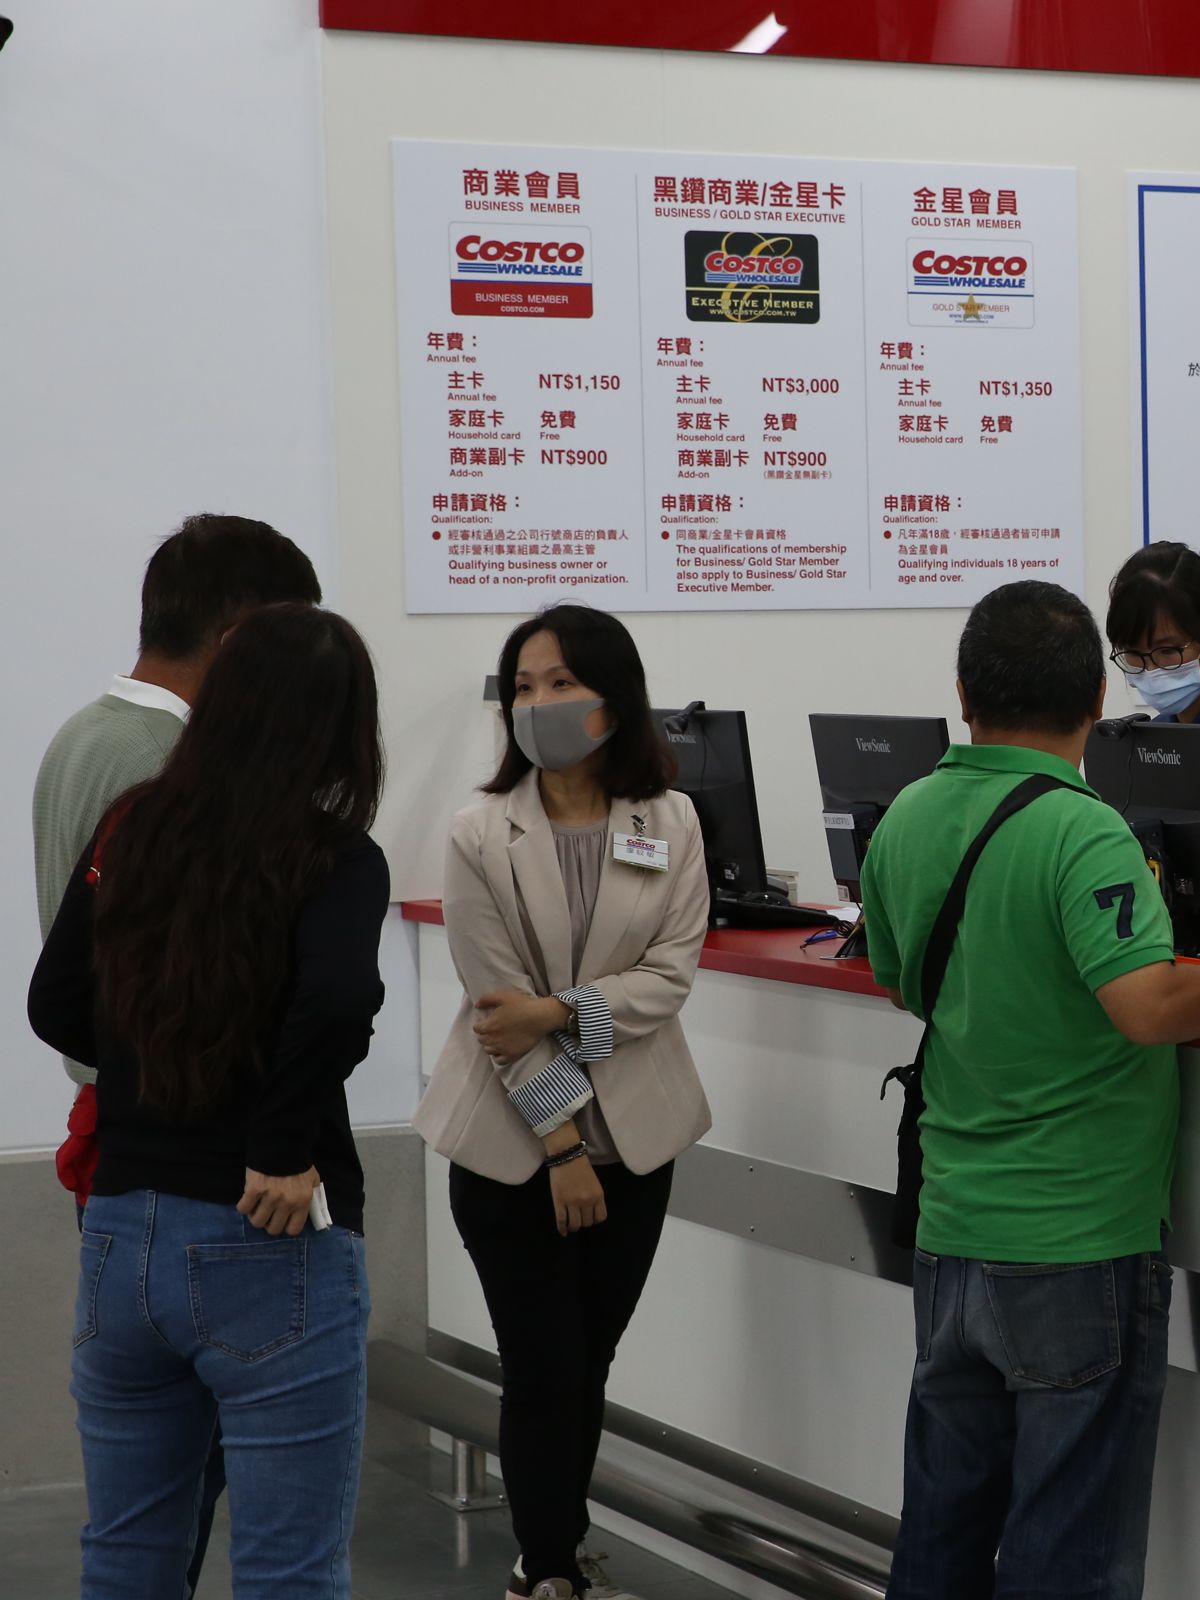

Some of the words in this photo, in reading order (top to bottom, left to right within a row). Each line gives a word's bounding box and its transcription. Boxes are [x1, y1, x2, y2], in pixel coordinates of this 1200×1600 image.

[462, 168, 581, 200] 商業會員
[653, 176, 846, 209] 黑鑽商業/金星卡
[465, 200, 524, 212] BUSINESS
[530, 202, 580, 214] MEMBER
[912, 186, 1018, 216] 金星會員
[655, 207, 711, 219] BUSINESS
[713, 209, 718, 219] /
[720, 209, 751, 220] GOLD
[754, 211, 782, 221] STAR
[911, 216, 941, 227] GOLD
[944, 217, 971, 228] STAR
[976, 219, 1021, 230] MEMBER
[455, 235, 585, 263] COSTCO
[704, 251, 803, 275] COSTCO
[912, 250, 1028, 276] COSTCO
[497, 264, 583, 276] WHOLESALE
[736, 274, 800, 284] WHOLESALE
[949, 277, 1026, 289] WHOLESALE
[475, 293, 523, 304] BUSINESS
[527, 294, 569, 304] MEMBER
[763, 297, 814, 309] MEMBER
[427, 354, 460, 363] Annual
[462, 355, 477, 364] fee
[657, 359, 688, 368] Annual
[690, 359, 704, 368] fee
[448, 371, 485, 390] 主卡
[539, 374, 620, 392] NT$1,150
[676, 375, 711, 393] 主卡
[762, 378, 839, 395] NT$3,000
[898, 378, 931, 396] 主卡
[980, 381, 1053, 398] NT$1,350
[447, 392, 480, 402] Annual
[482, 393, 497, 402] fee
[448, 409, 505, 428] 家庭卡
[540, 410, 576, 429] 免費
[677, 412, 730, 431] 家庭卡
[764, 413, 798, 431] 免費
[899, 415, 949, 433] 家庭卡
[981, 415, 1013, 433] 免費
[448, 431, 499, 440] Household
[500, 432, 521, 440] card
[540, 432, 561, 441] Free
[677, 433, 724, 442] Household
[725, 434, 745, 442] card
[763, 433, 783, 443] Free
[449, 447, 526, 466] 商業副卡
[541, 449, 608, 466] NT$900
[678, 449, 750, 468] 商業副卡
[764, 451, 827, 467] NT$900
[449, 469, 484, 478] Add-on
[677, 470, 710, 479] Add-on
[431, 515, 493, 524] Qualification:
[660, 515, 719, 524] Qualification:
[883, 515, 938, 524] Qualification:
[676, 544, 696, 555] The
[698, 544, 768, 556] qualifications
[771, 544, 781, 554] of
[784, 544, 847, 555] membership
[448, 560, 505, 572] Qualifying
[508, 560, 558, 570] business
[560, 561, 594, 570] owner
[596, 561, 608, 569] or
[676, 557, 692, 567] for
[694, 557, 746, 567] Business/
[748, 557, 773, 567] Gold
[775, 557, 796, 567] Star
[799, 557, 840, 566] Member
[898, 559, 949, 571] Qualifying
[951, 559, 1004, 568] individuals
[1007, 558, 1018, 568] 18
[1020, 560, 1047, 570] years
[1049, 558, 1059, 568] of
[449, 575, 476, 585] head
[479, 574, 490, 585] of
[493, 576, 500, 585] a
[502, 574, 557, 586] non-profit
[559, 575, 629, 586] organization.
[676, 570, 699, 580] also
[701, 570, 730, 582] apply
[732, 570, 743, 580] to
[746, 569, 797, 580] Business/
[799, 569, 824, 579] Gold
[826, 569, 847, 579] Star
[898, 575, 917, 585] age
[919, 573, 937, 583] and
[939, 575, 964, 583] over.
[677, 583, 728, 593] Executive
[731, 583, 774, 592] Member.
[856, 738, 891, 753] ViewSonic
[1137, 747, 1181, 766] ViewSonic
[626, 839, 656, 849] COSTCO
[1092, 882, 1136, 940] 7
